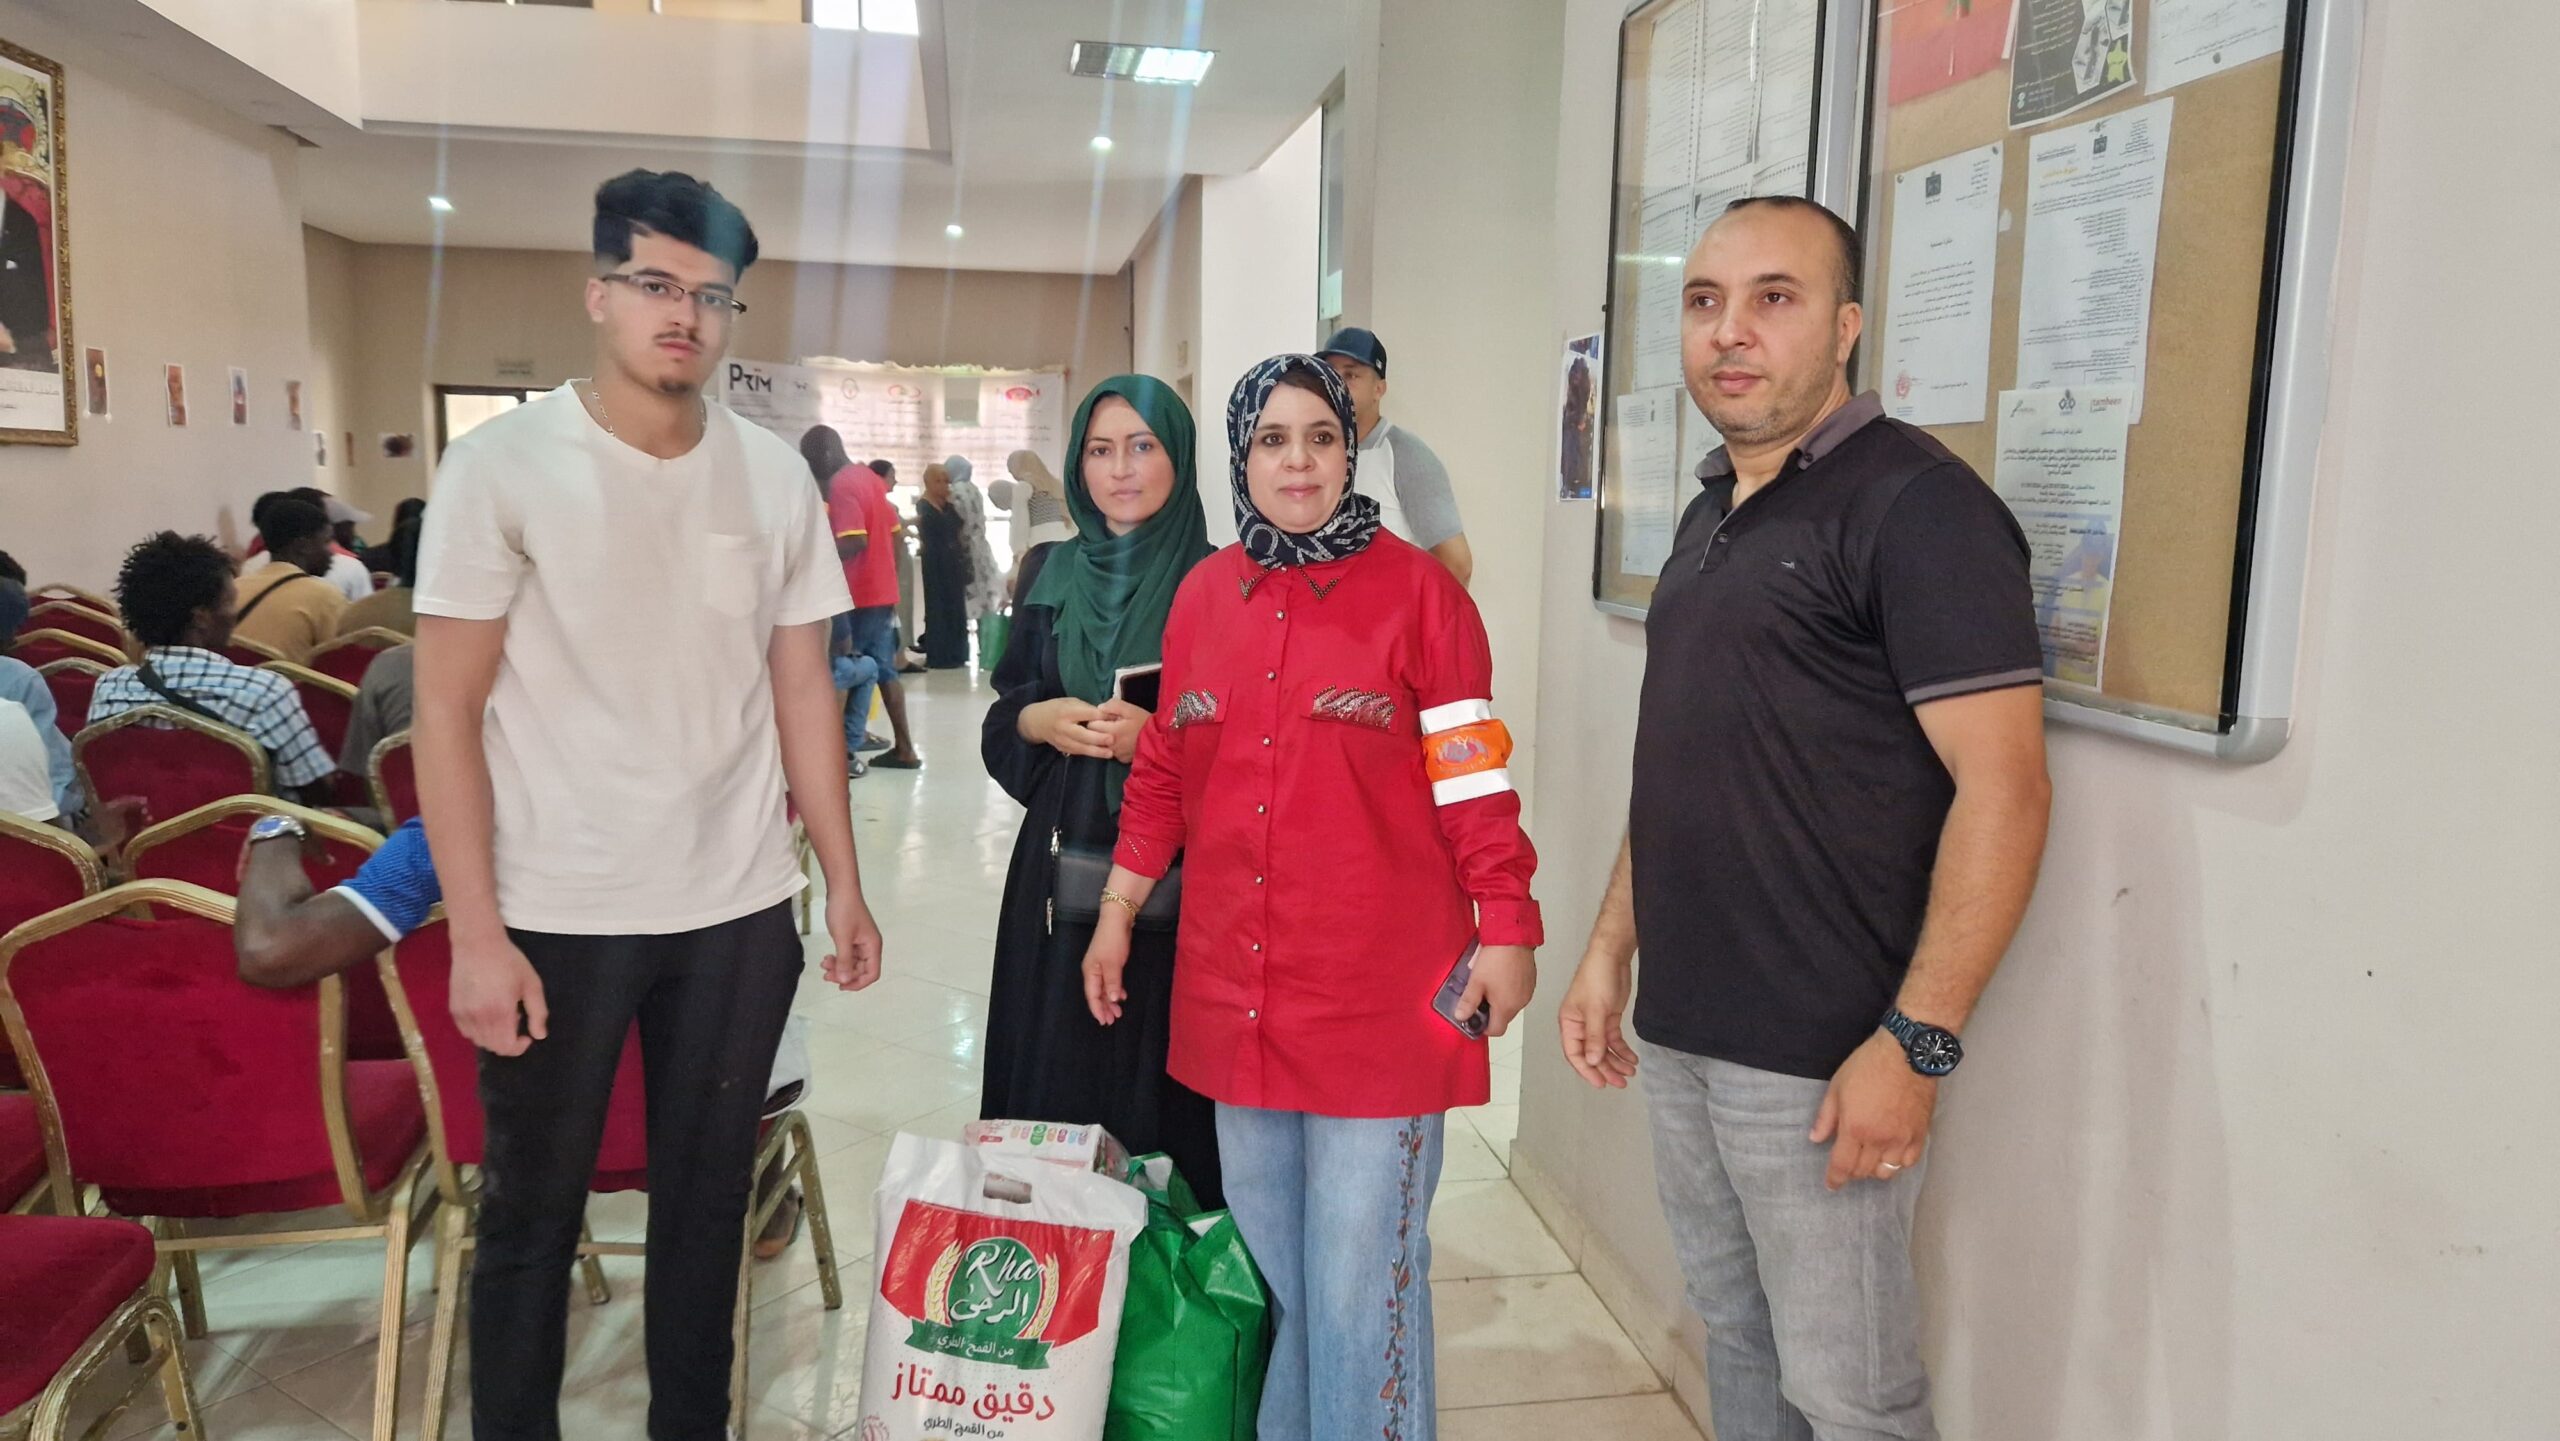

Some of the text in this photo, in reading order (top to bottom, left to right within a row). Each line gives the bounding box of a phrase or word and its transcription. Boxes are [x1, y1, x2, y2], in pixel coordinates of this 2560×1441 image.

[937, 1333, 1015, 1358] من القمح الطري
[891, 1362, 1056, 1423] دقيق ممتاز
[923, 1416, 1004, 1439] من القمح الطري
